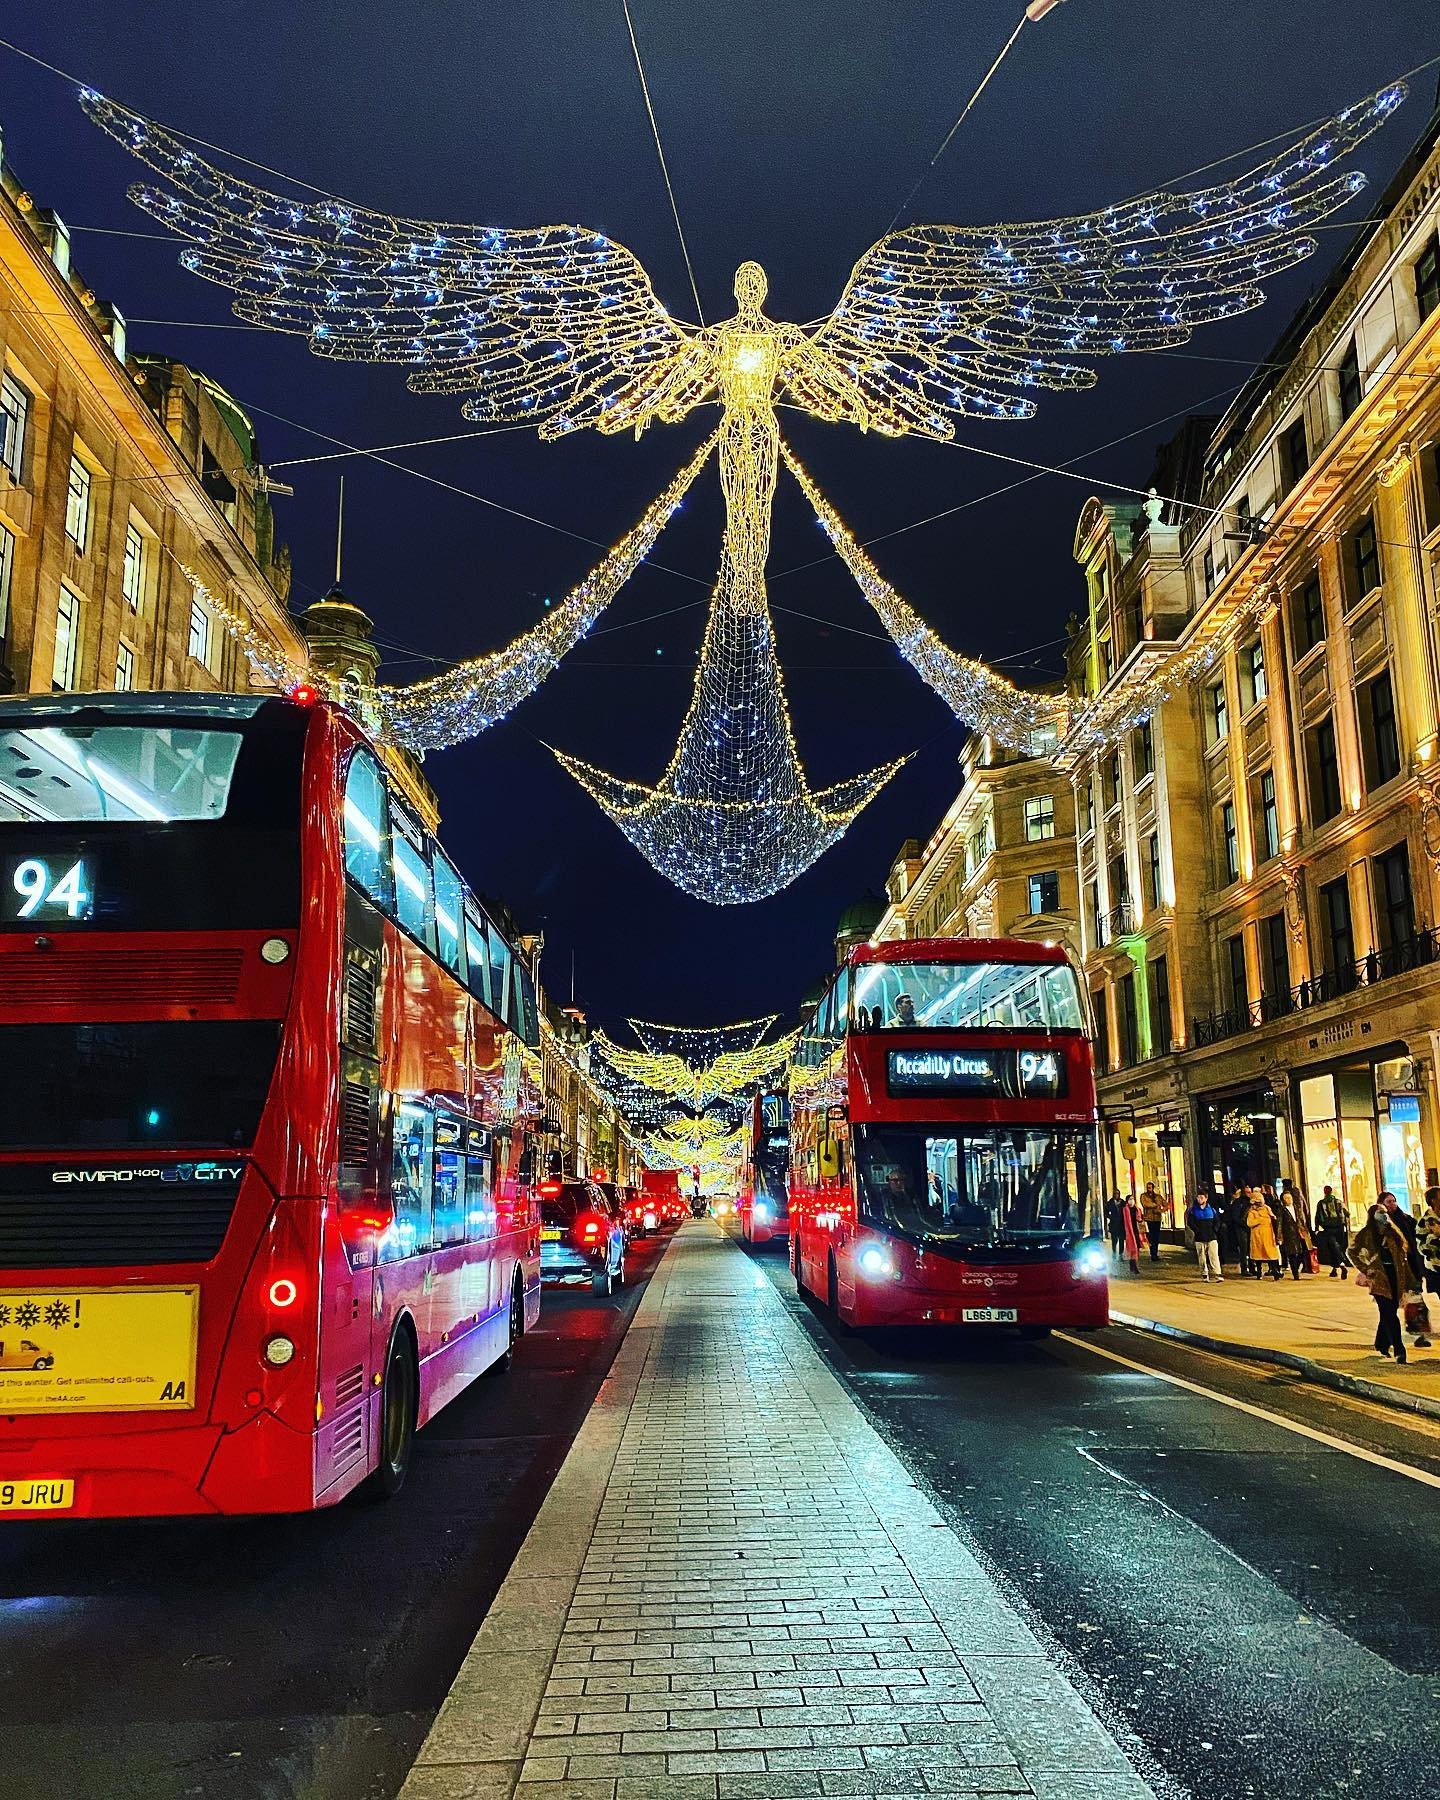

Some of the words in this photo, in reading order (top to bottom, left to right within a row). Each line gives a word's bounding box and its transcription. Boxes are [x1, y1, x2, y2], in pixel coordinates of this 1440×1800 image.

[13, 859, 88, 917] 94
[896, 1056, 950, 1079] Piccadilly
[953, 1056, 988, 1075] Circus
[1020, 1055, 1056, 1082] 94
[7, 1378, 22, 1387] this
[56, 1377, 72, 1386] Get
[74, 1376, 115, 1385] unlimited
[117, 1375, 156, 1384] call-outs.
[160, 1381, 186, 1401] AA
[21, 1483, 64, 1505] JRU
